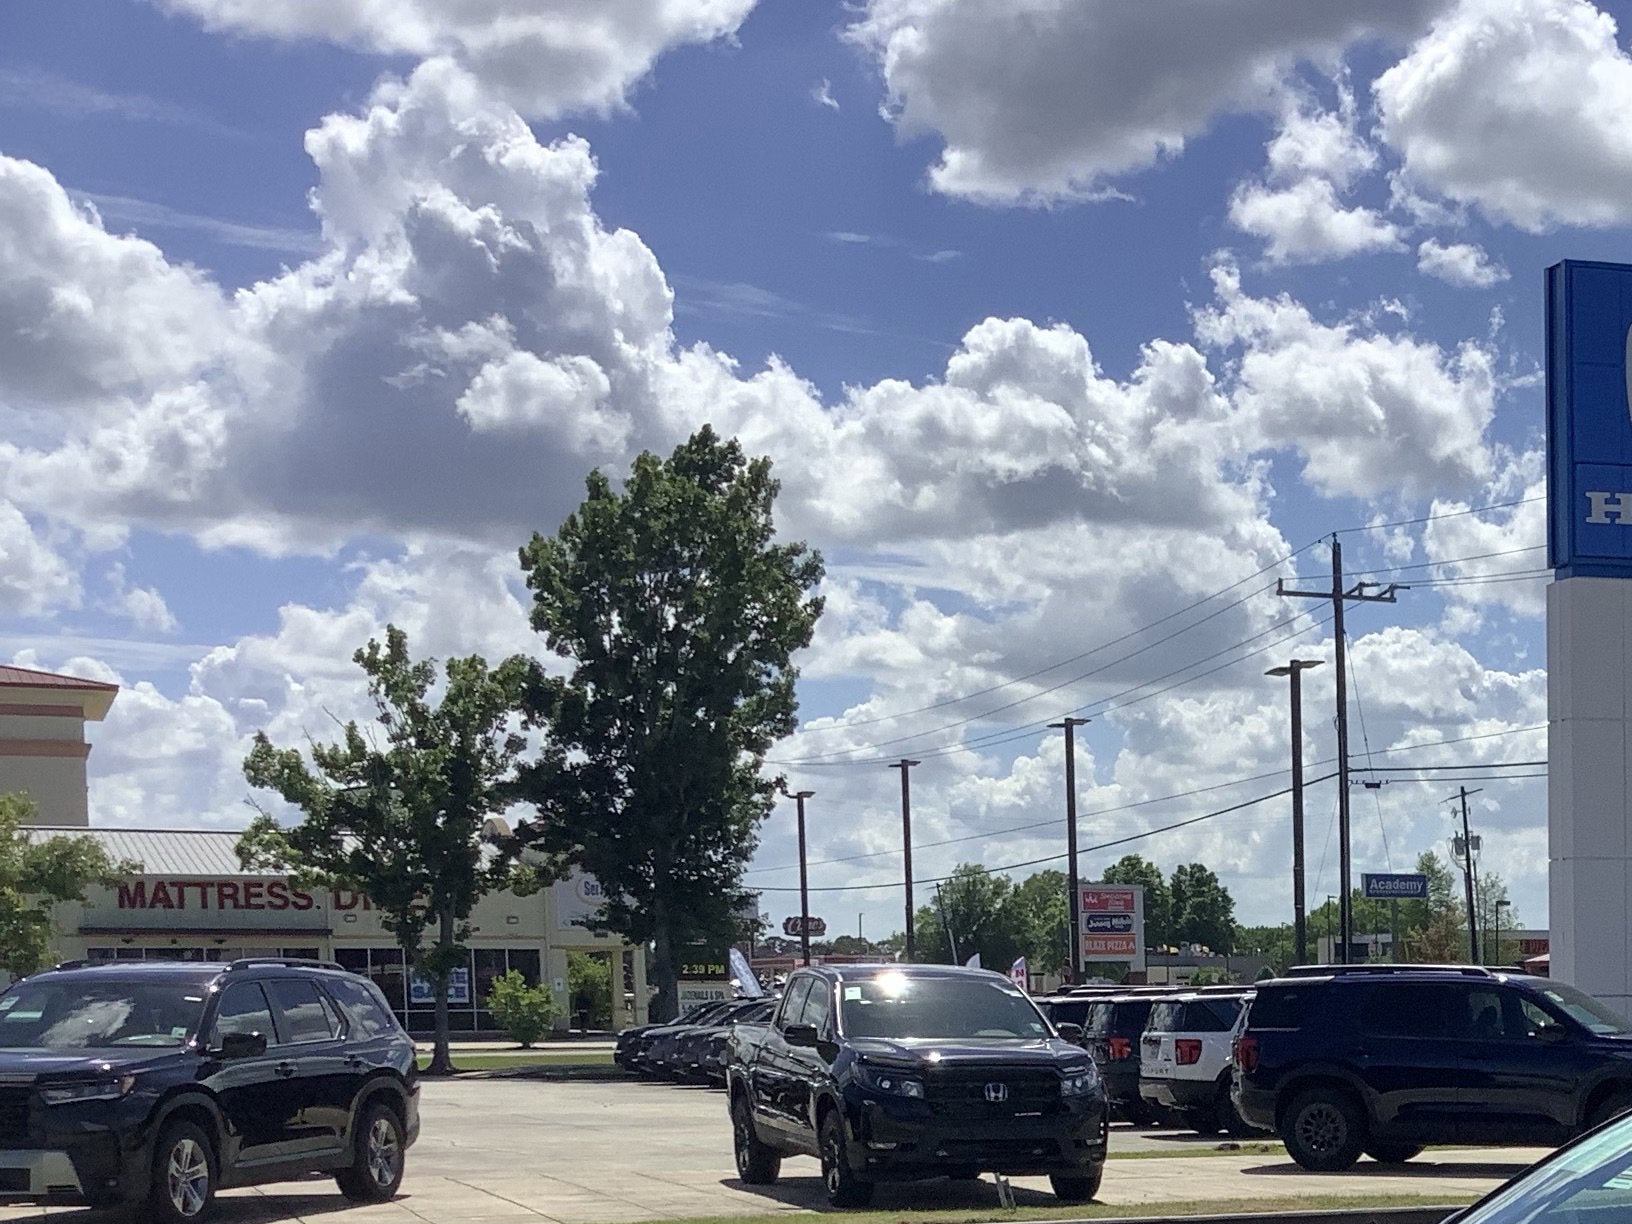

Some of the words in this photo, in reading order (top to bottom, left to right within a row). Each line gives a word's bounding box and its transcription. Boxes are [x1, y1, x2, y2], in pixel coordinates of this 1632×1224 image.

[1369, 879, 1424, 894] Academy
[1106, 941, 1127, 951] PIZZA
[707, 964, 726, 975] PM
